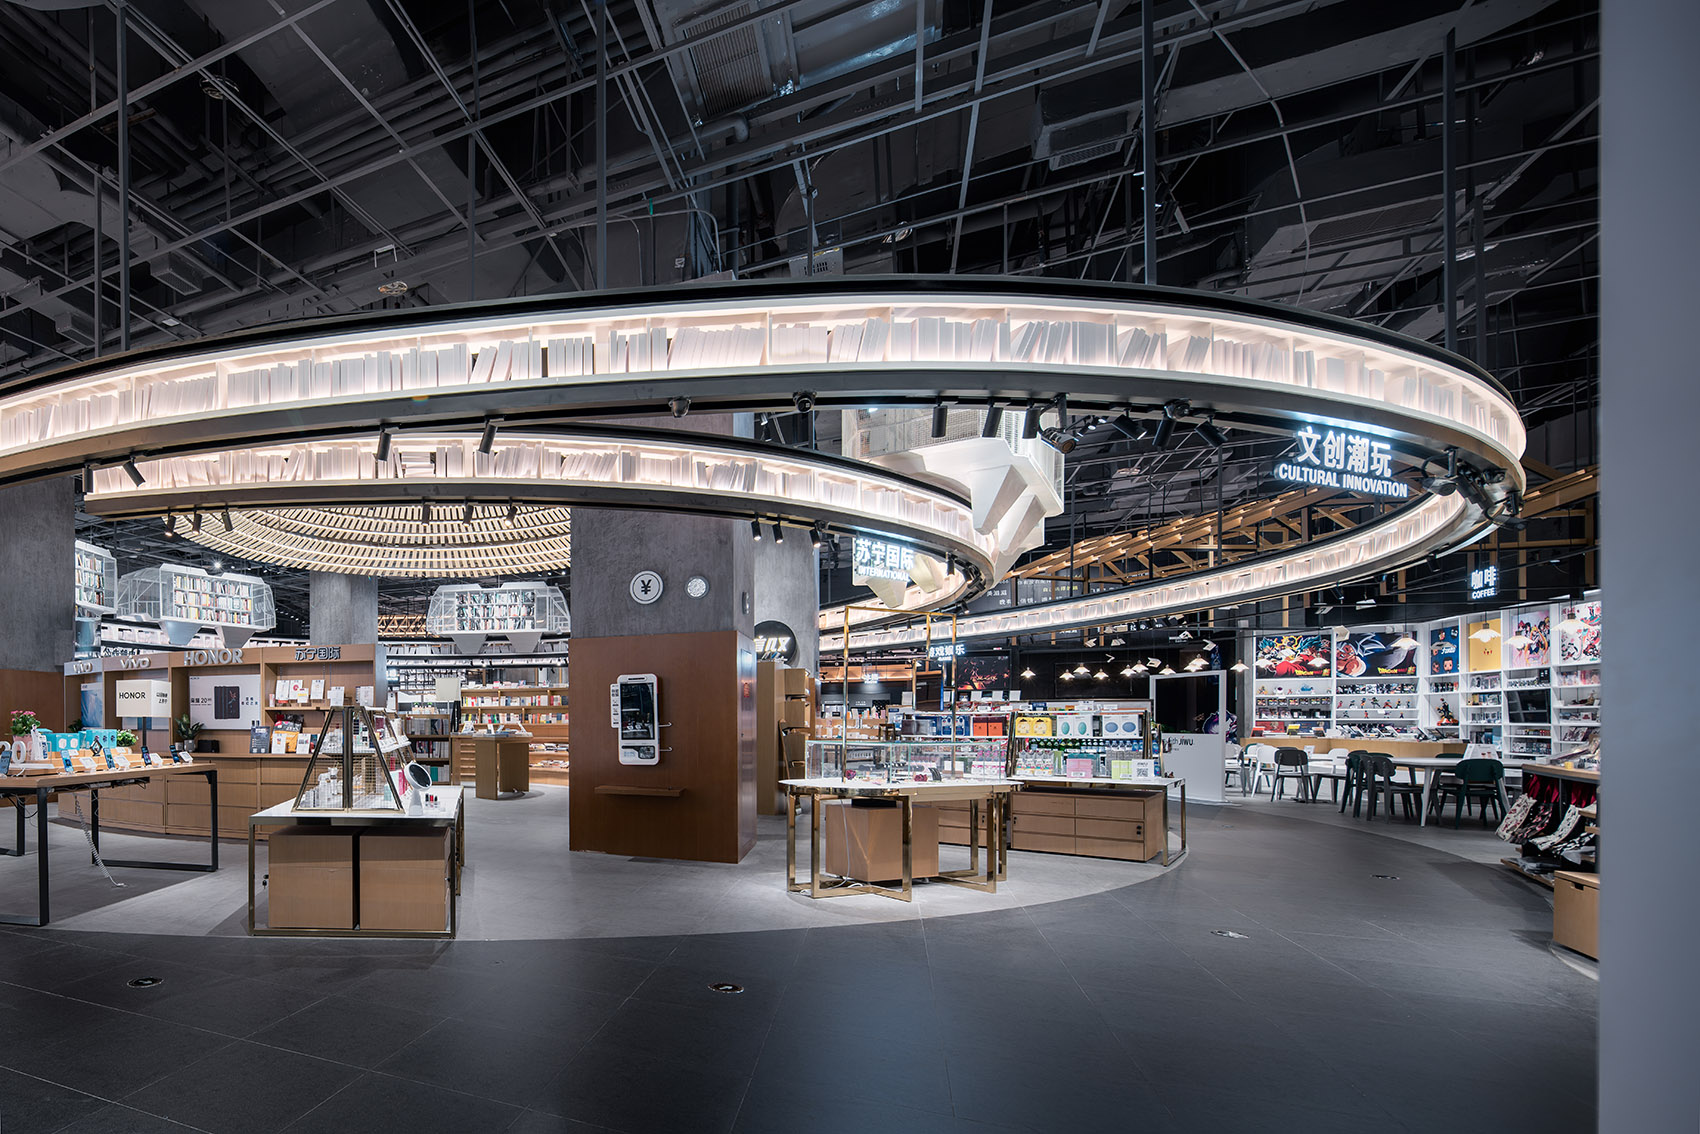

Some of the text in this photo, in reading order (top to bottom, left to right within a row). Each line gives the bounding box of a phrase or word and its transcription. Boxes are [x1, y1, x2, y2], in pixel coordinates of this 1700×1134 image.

[1297, 425, 1392, 478] 文创潮玩
[1278, 463, 1408, 498] CULTURAL INNOVATION
[856, 538, 914, 570] 苏宁国际
[1471, 565, 1497, 590] 咖啡
[1472, 587, 1495, 600] COFFEE
[120, 655, 151, 669] vivo
[184, 648, 244, 666] HONOR
[295, 647, 341, 661] 苏宁国际
